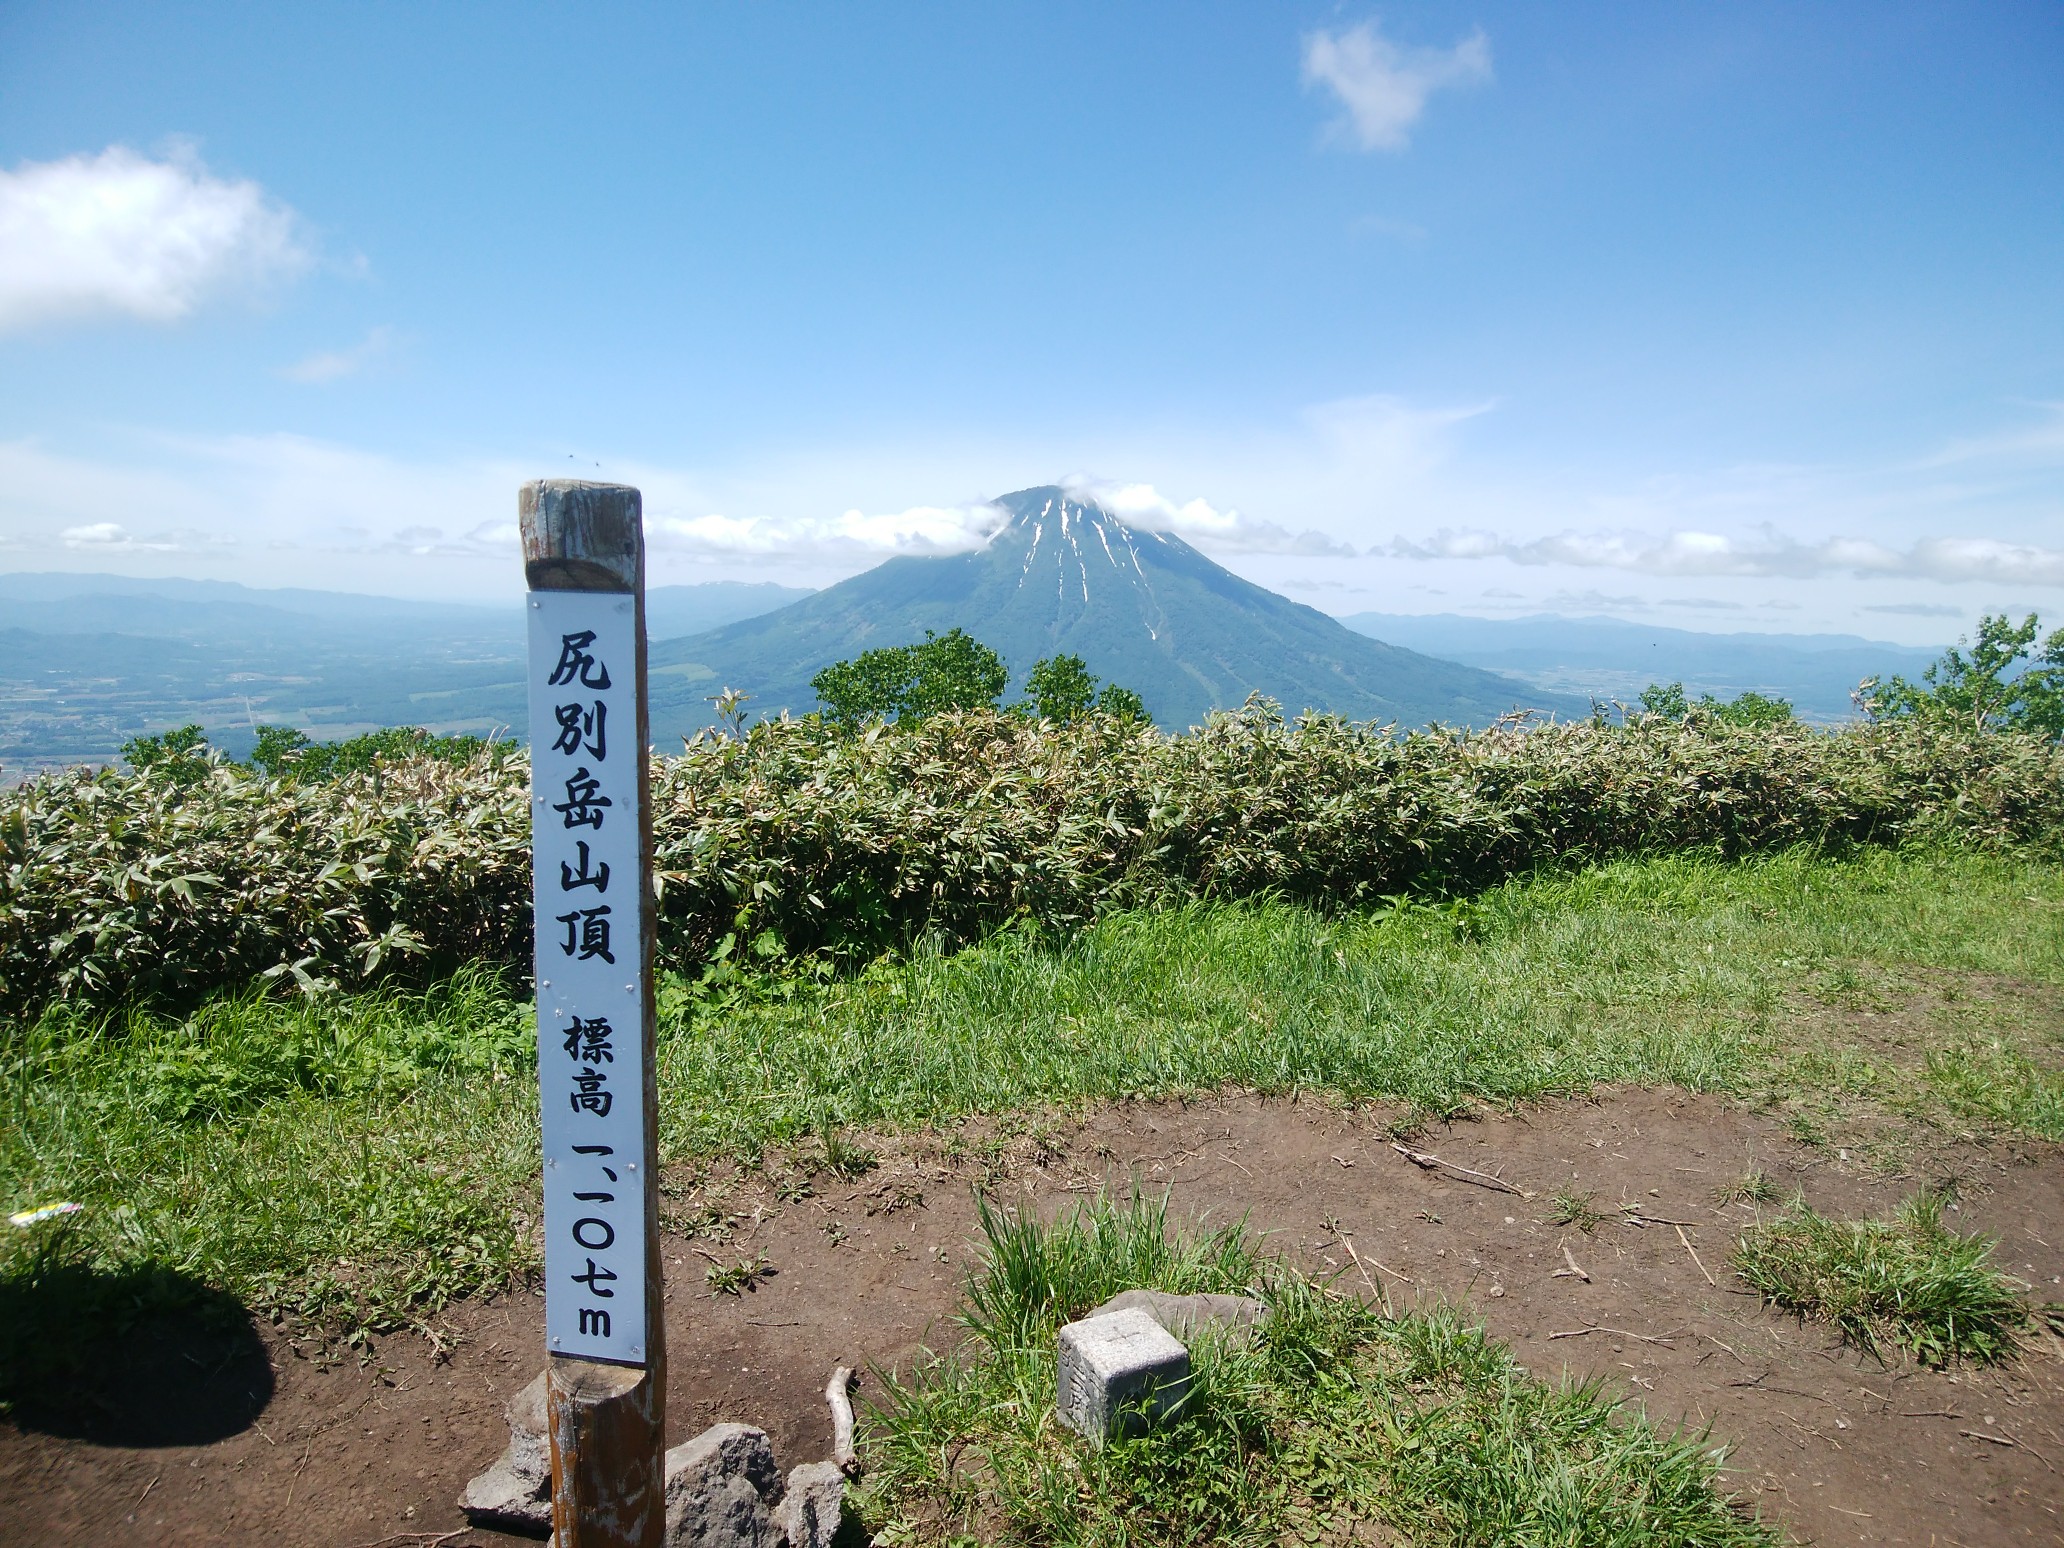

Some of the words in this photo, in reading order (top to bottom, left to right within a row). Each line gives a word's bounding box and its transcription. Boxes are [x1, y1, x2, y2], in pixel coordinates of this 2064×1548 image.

[548, 629, 616, 965] 尻別岳山頂
[562, 1015, 614, 1118] 標高
